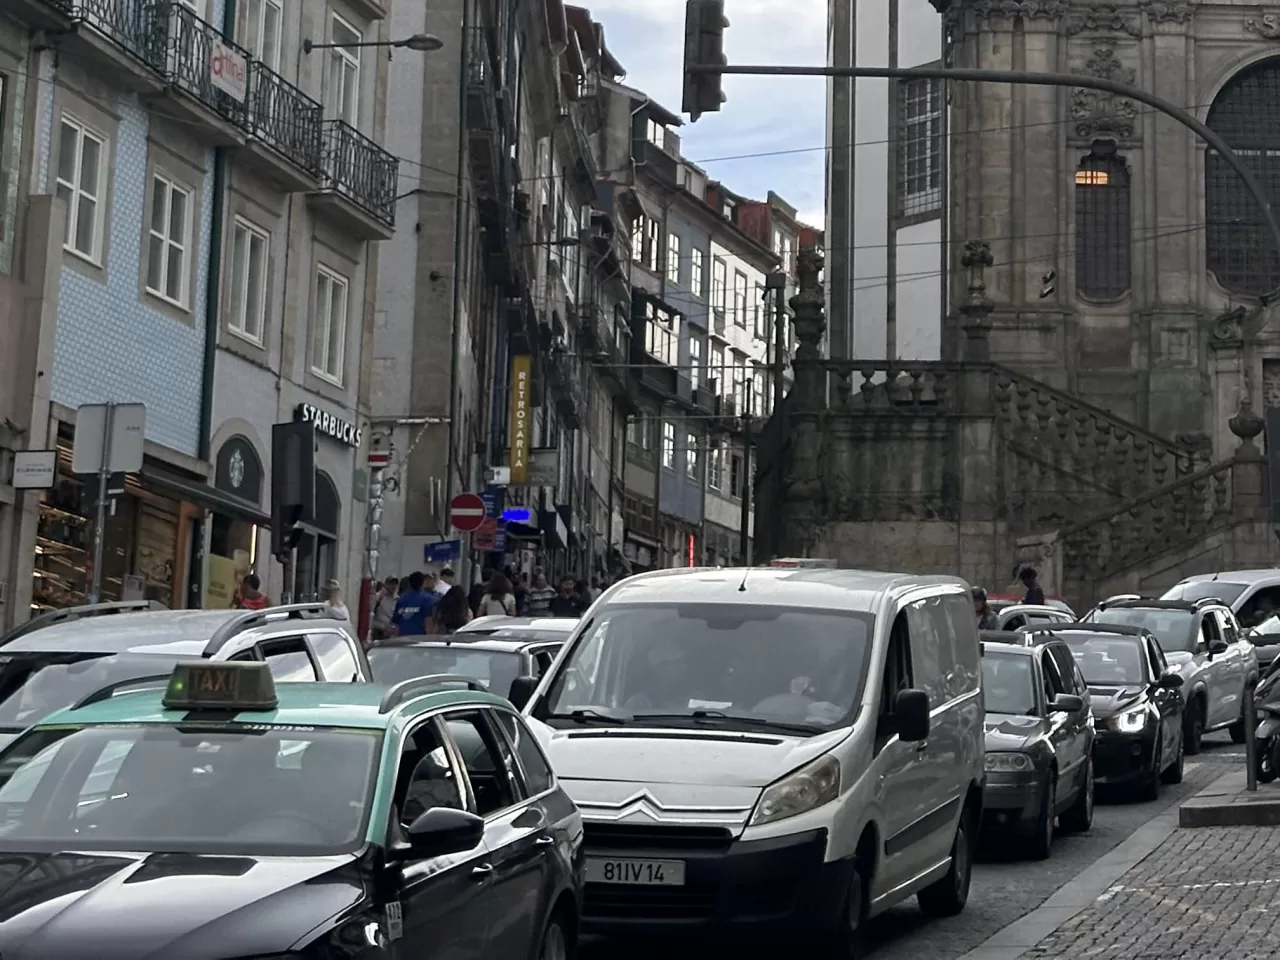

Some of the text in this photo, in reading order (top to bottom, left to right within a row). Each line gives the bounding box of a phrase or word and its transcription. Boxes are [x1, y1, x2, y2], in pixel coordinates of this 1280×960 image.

[302, 402, 362, 448] STARBUCKS
[515, 371, 526, 468] RETROSARIA
[192, 670, 234, 691] TAXI
